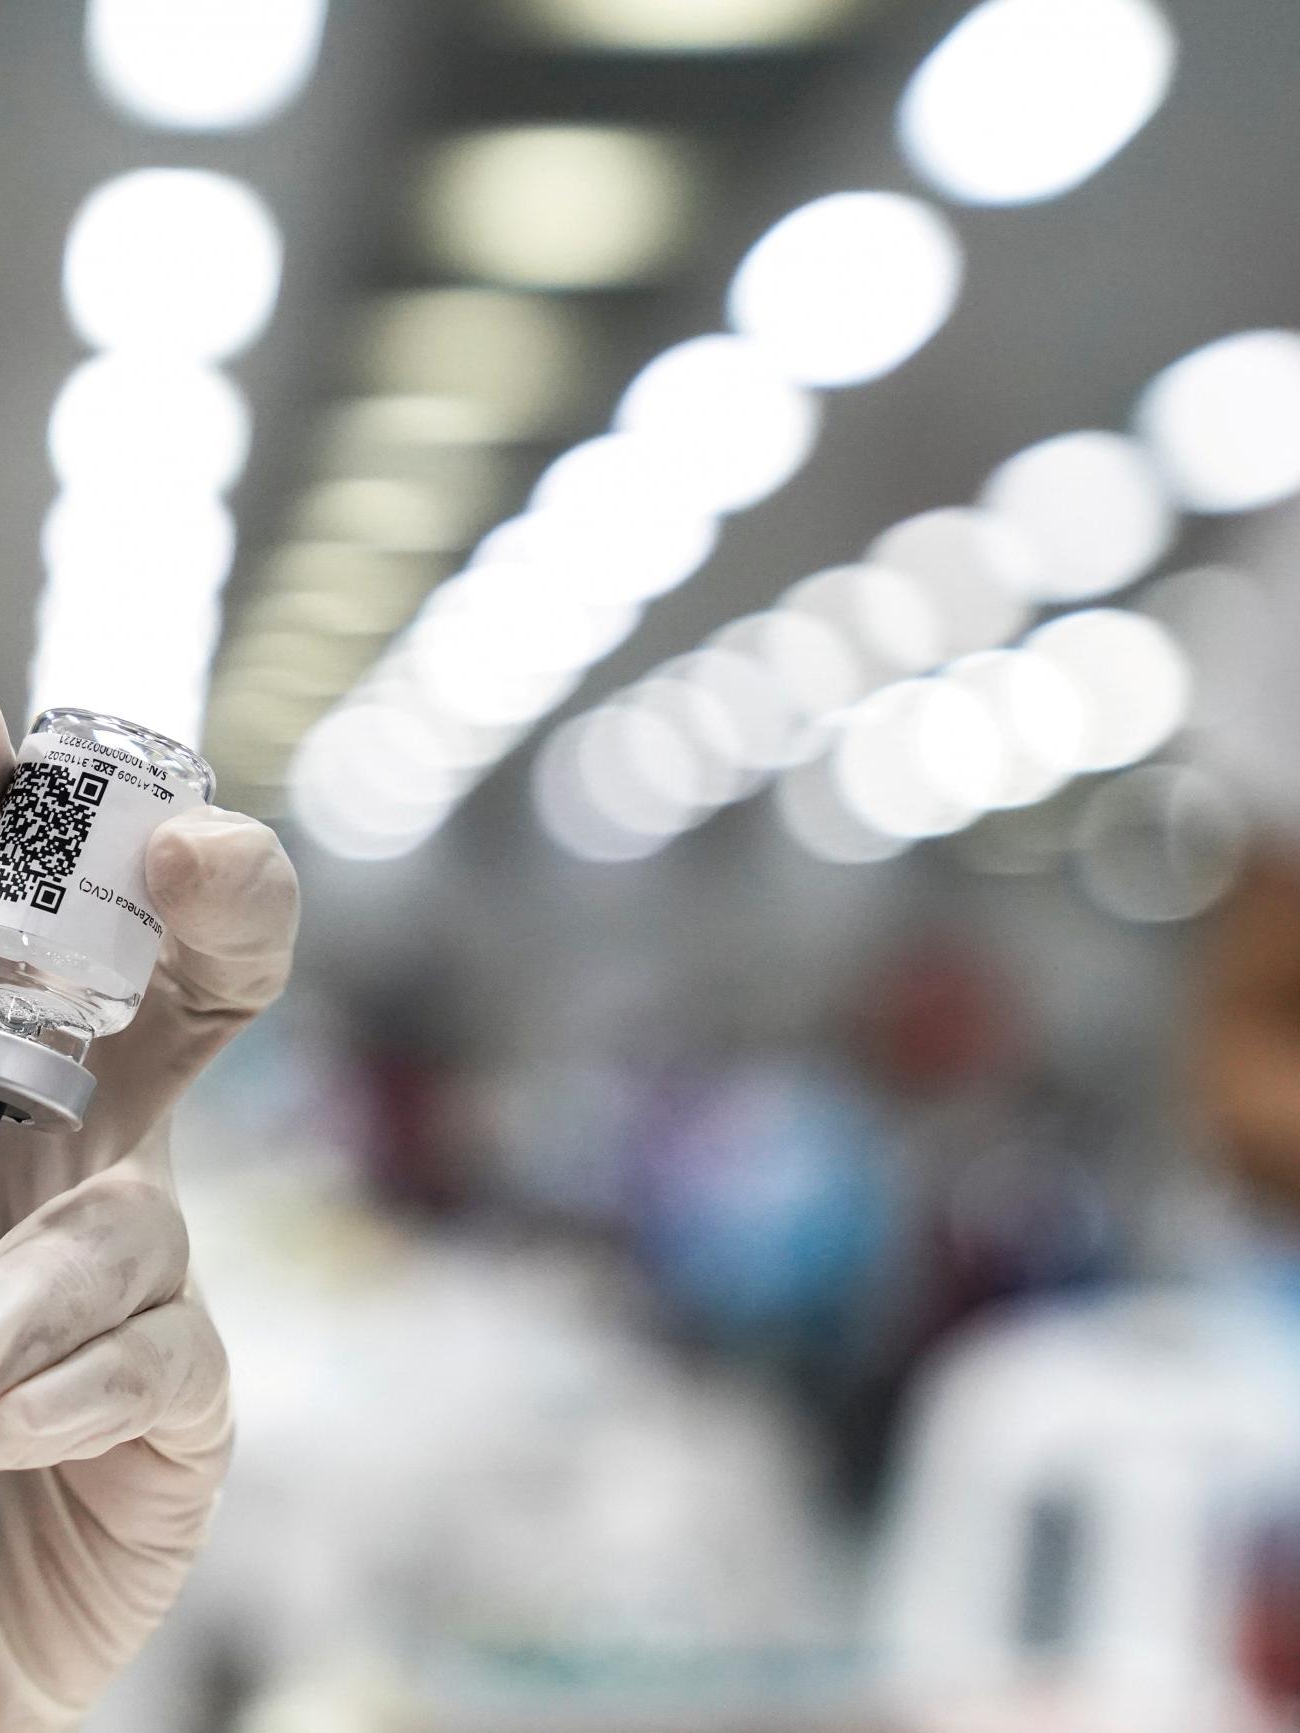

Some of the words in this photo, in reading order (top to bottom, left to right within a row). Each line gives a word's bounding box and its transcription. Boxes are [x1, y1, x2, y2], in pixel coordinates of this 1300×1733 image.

[44, 750, 89, 768] 31102021
[91, 758, 118, 777] EXP:
[118, 770, 150, 790] A1009
[146, 764, 168, 781] S/N:
[151, 783, 174, 804] LOT:
[79, 877, 114, 903] (CVC)
